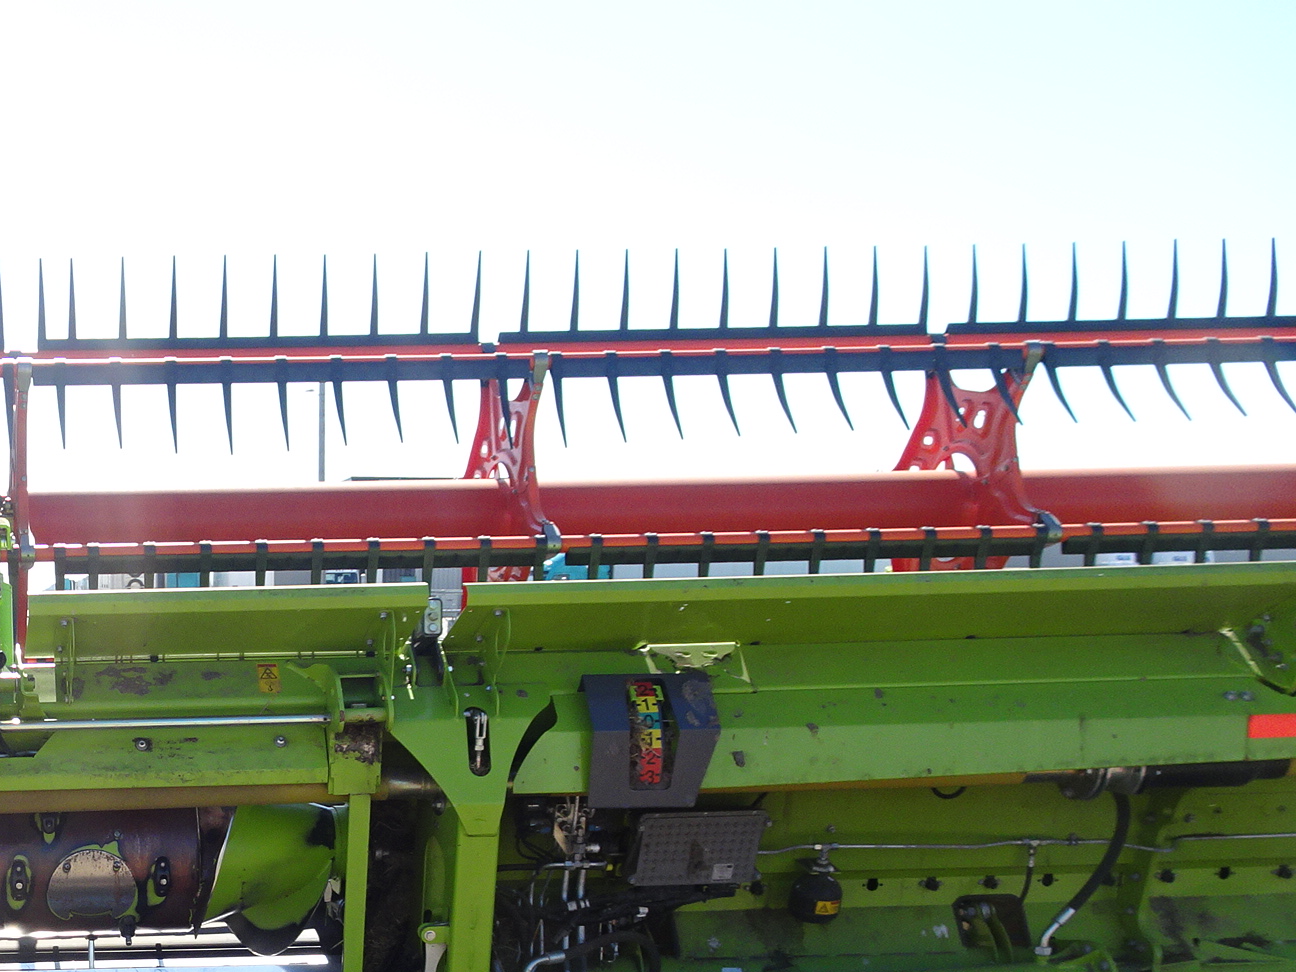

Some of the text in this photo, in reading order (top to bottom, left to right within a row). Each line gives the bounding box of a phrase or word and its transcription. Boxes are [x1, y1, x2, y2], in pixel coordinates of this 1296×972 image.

[642, 698, 650, 711] 1
[643, 714, 654, 729] 0
[646, 750, 657, 765] 2
